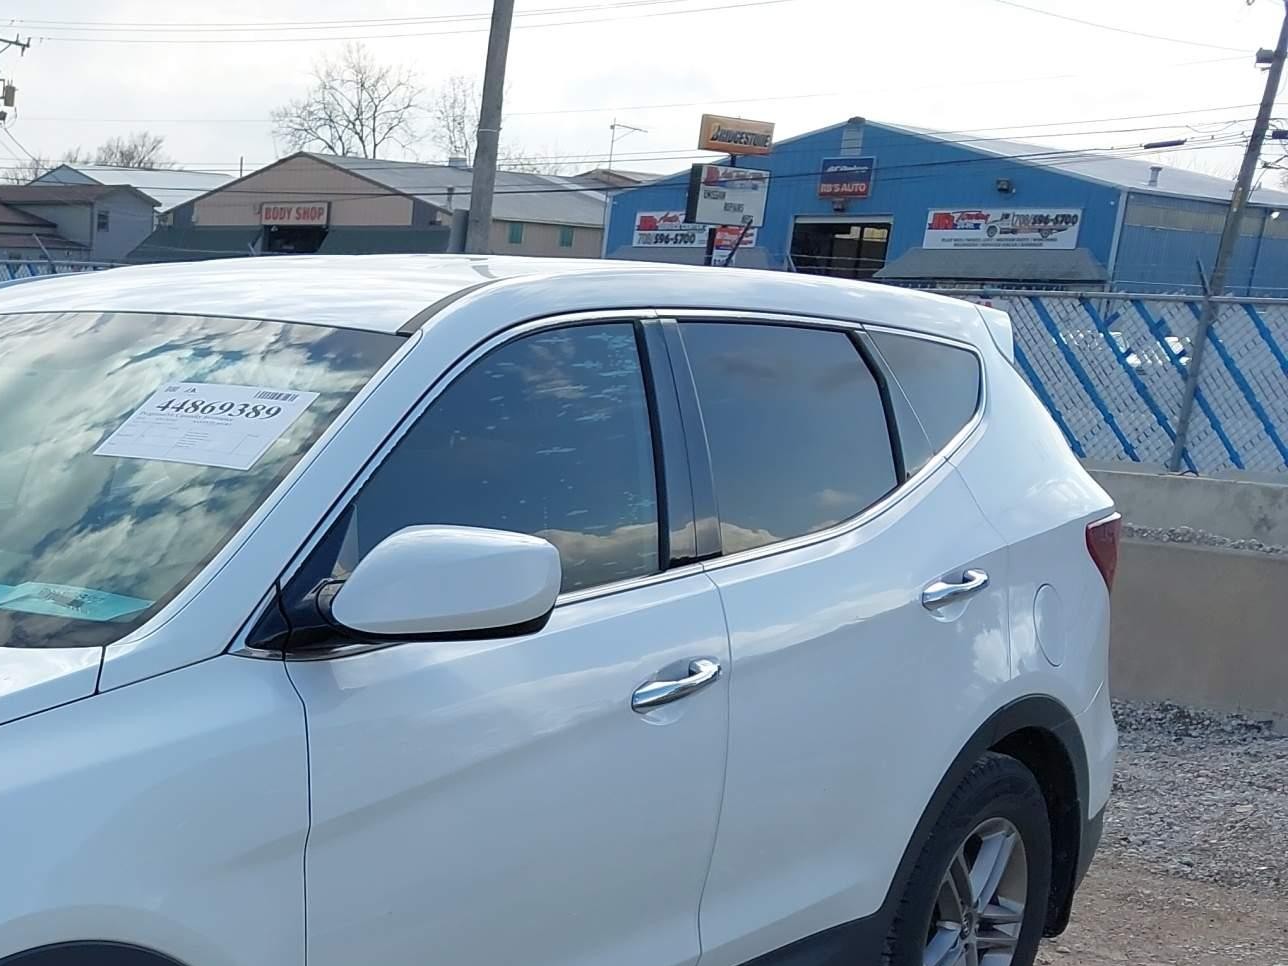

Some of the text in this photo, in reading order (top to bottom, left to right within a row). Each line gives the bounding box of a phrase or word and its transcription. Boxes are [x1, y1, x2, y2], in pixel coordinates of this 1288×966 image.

[841, 183, 866, 192] AUTO
[264, 206, 325, 220] BODY SHOP
[155, 398, 282, 420] 44869389
